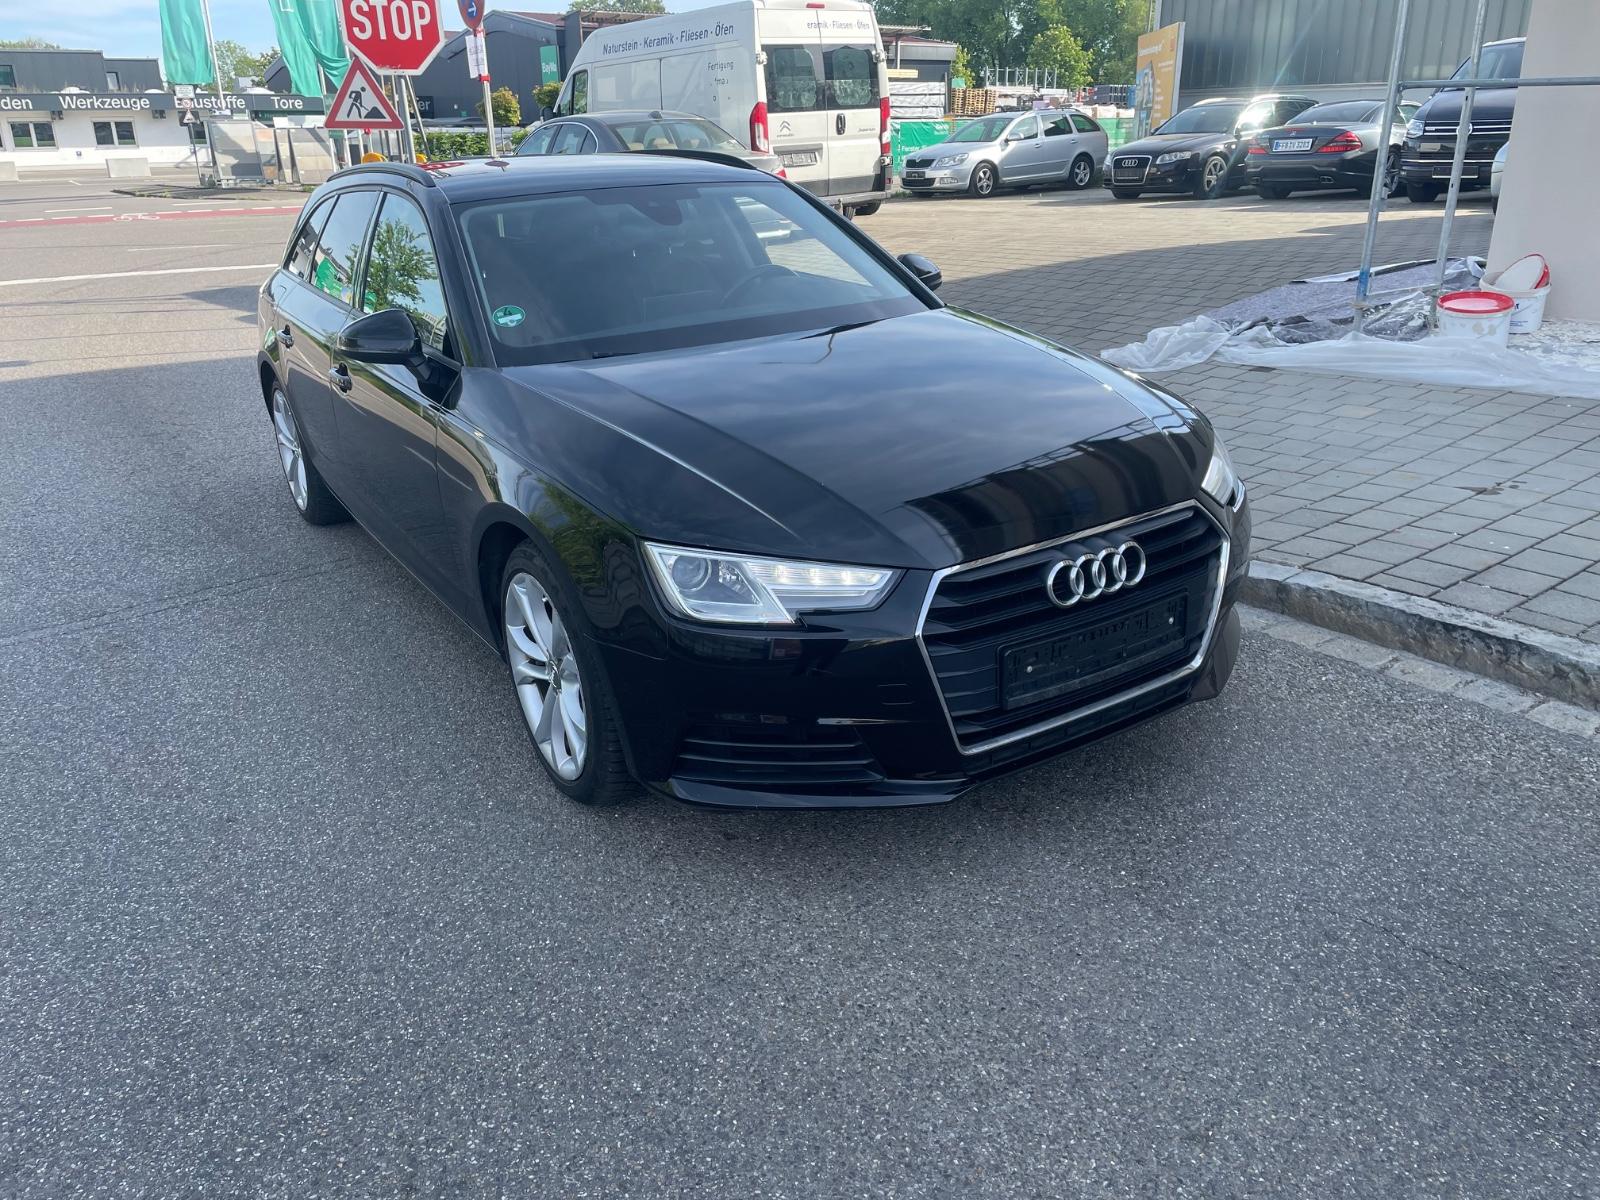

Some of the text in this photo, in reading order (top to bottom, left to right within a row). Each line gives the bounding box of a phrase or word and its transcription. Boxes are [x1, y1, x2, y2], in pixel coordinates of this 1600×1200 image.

[350, 0, 431, 41] STOP
[603, 21, 734, 55] Naturstein Keramik Fliesen Öfen
[59, 95, 150, 111] Werkzeuge
[270, 96, 304, 109] Tore
